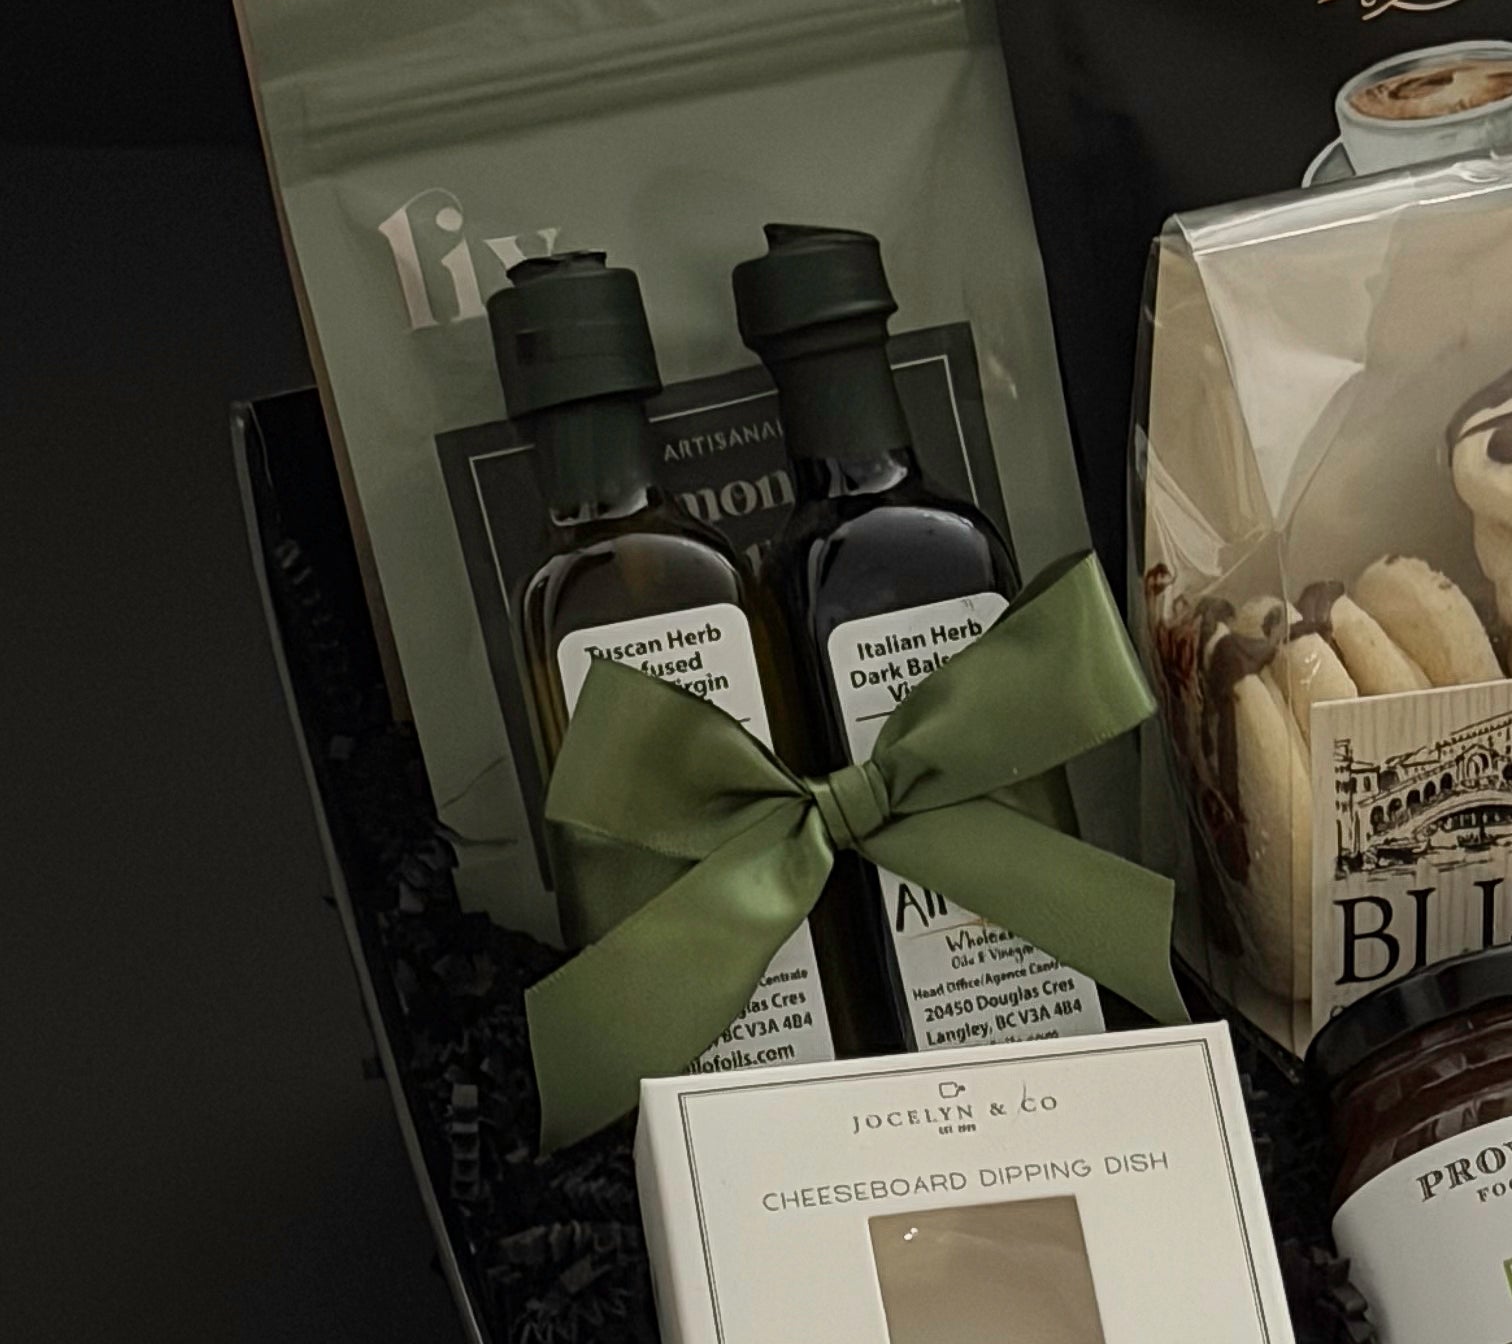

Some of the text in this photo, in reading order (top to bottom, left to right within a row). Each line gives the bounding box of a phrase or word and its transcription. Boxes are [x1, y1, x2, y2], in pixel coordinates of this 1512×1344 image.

[666, 623, 722, 649] Herb
[857, 618, 983, 660] Italian Herb
[850, 662, 904, 689] Dark
[771, 990, 807, 1009] Cres
[924, 978, 1075, 1022] 20450 Douglas Cres
[1018, 1007, 1052, 1026] V3A
[1053, 998, 1083, 1017] 4B4
[746, 1018, 780, 1038] V3A
[783, 1011, 813, 1030] 4B4
[853, 1104, 974, 1134] JOCELYN
[990, 1102, 1007, 1116] &
[763, 1151, 1169, 1212] CHEESEBOARD DIPPING DISH
